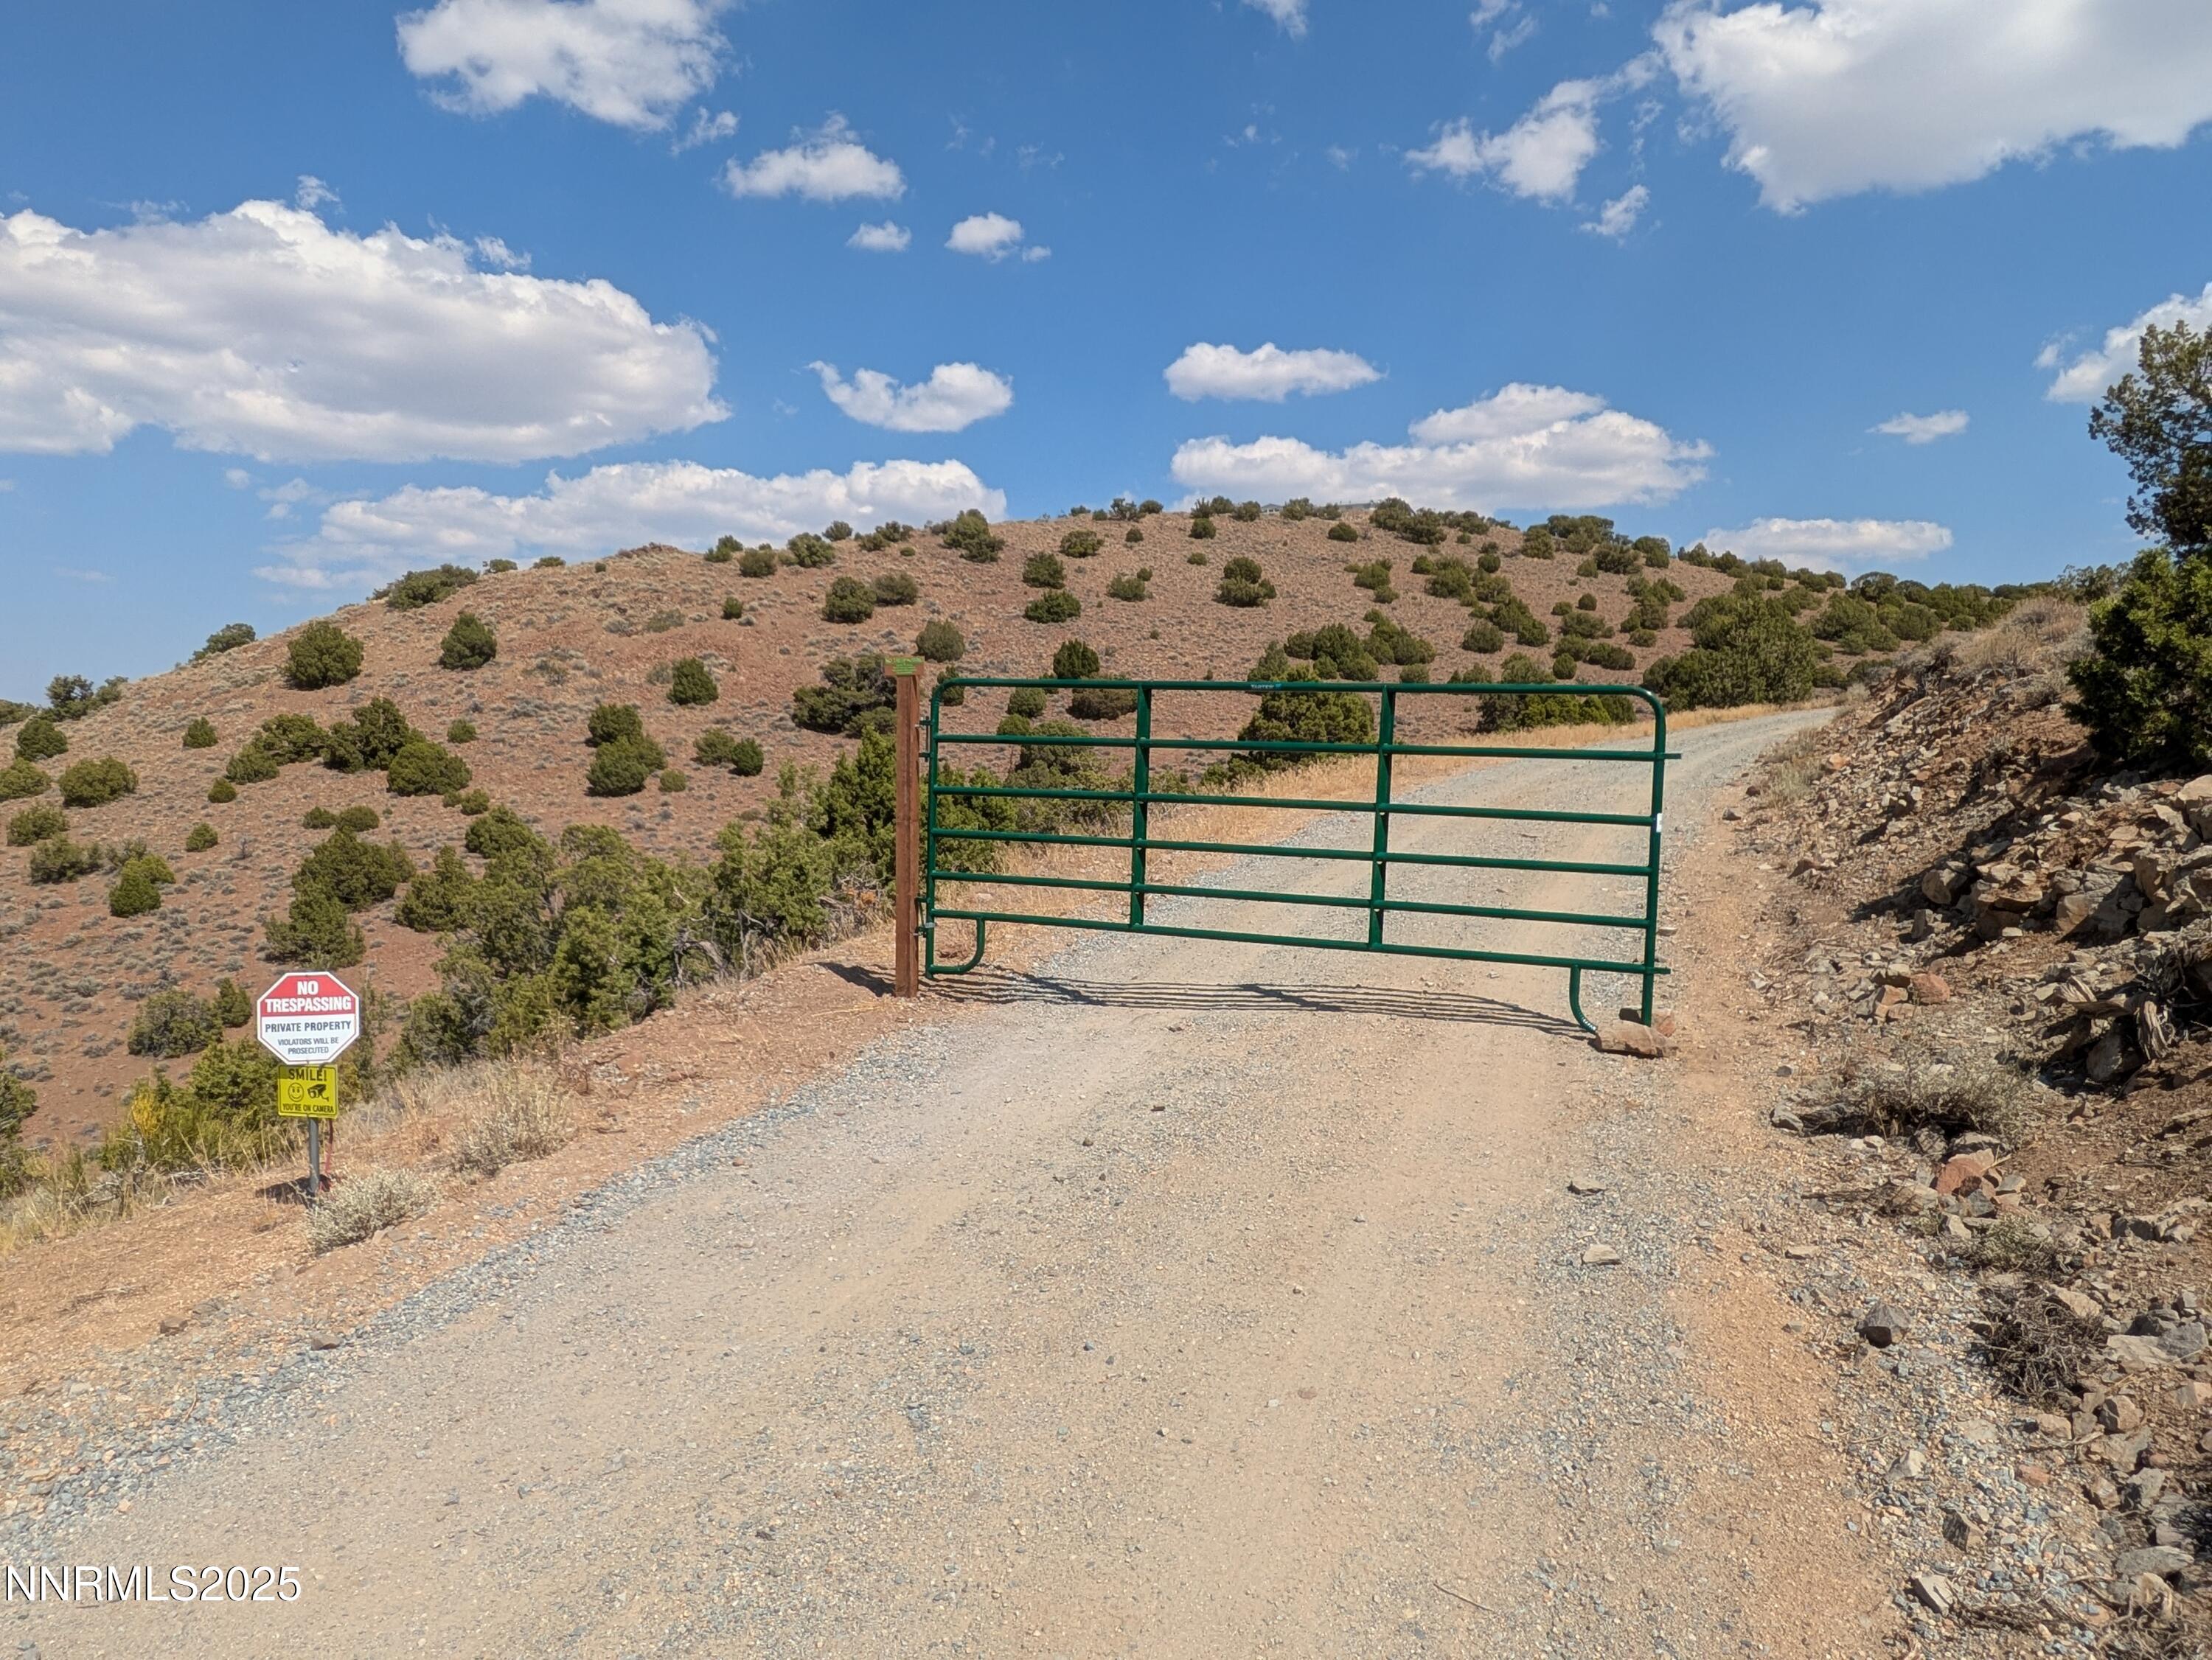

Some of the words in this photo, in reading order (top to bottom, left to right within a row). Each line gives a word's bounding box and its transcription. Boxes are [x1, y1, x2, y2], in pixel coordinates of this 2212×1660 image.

[297, 980, 319, 995] NO
[265, 996, 352, 1013] TRESPASSING
[265, 1022, 302, 1033] PRIVATE
[305, 1020, 351, 1031] PROPERTY
[277, 1038, 312, 1046] VIOLATORS
[330, 1036, 339, 1045] BE
[288, 1047, 329, 1055] PROSECUTED
[282, 1103, 302, 1112] YOU'RE
[303, 1103, 311, 1112] ON
[313, 1105, 334, 1113] CAMERA
